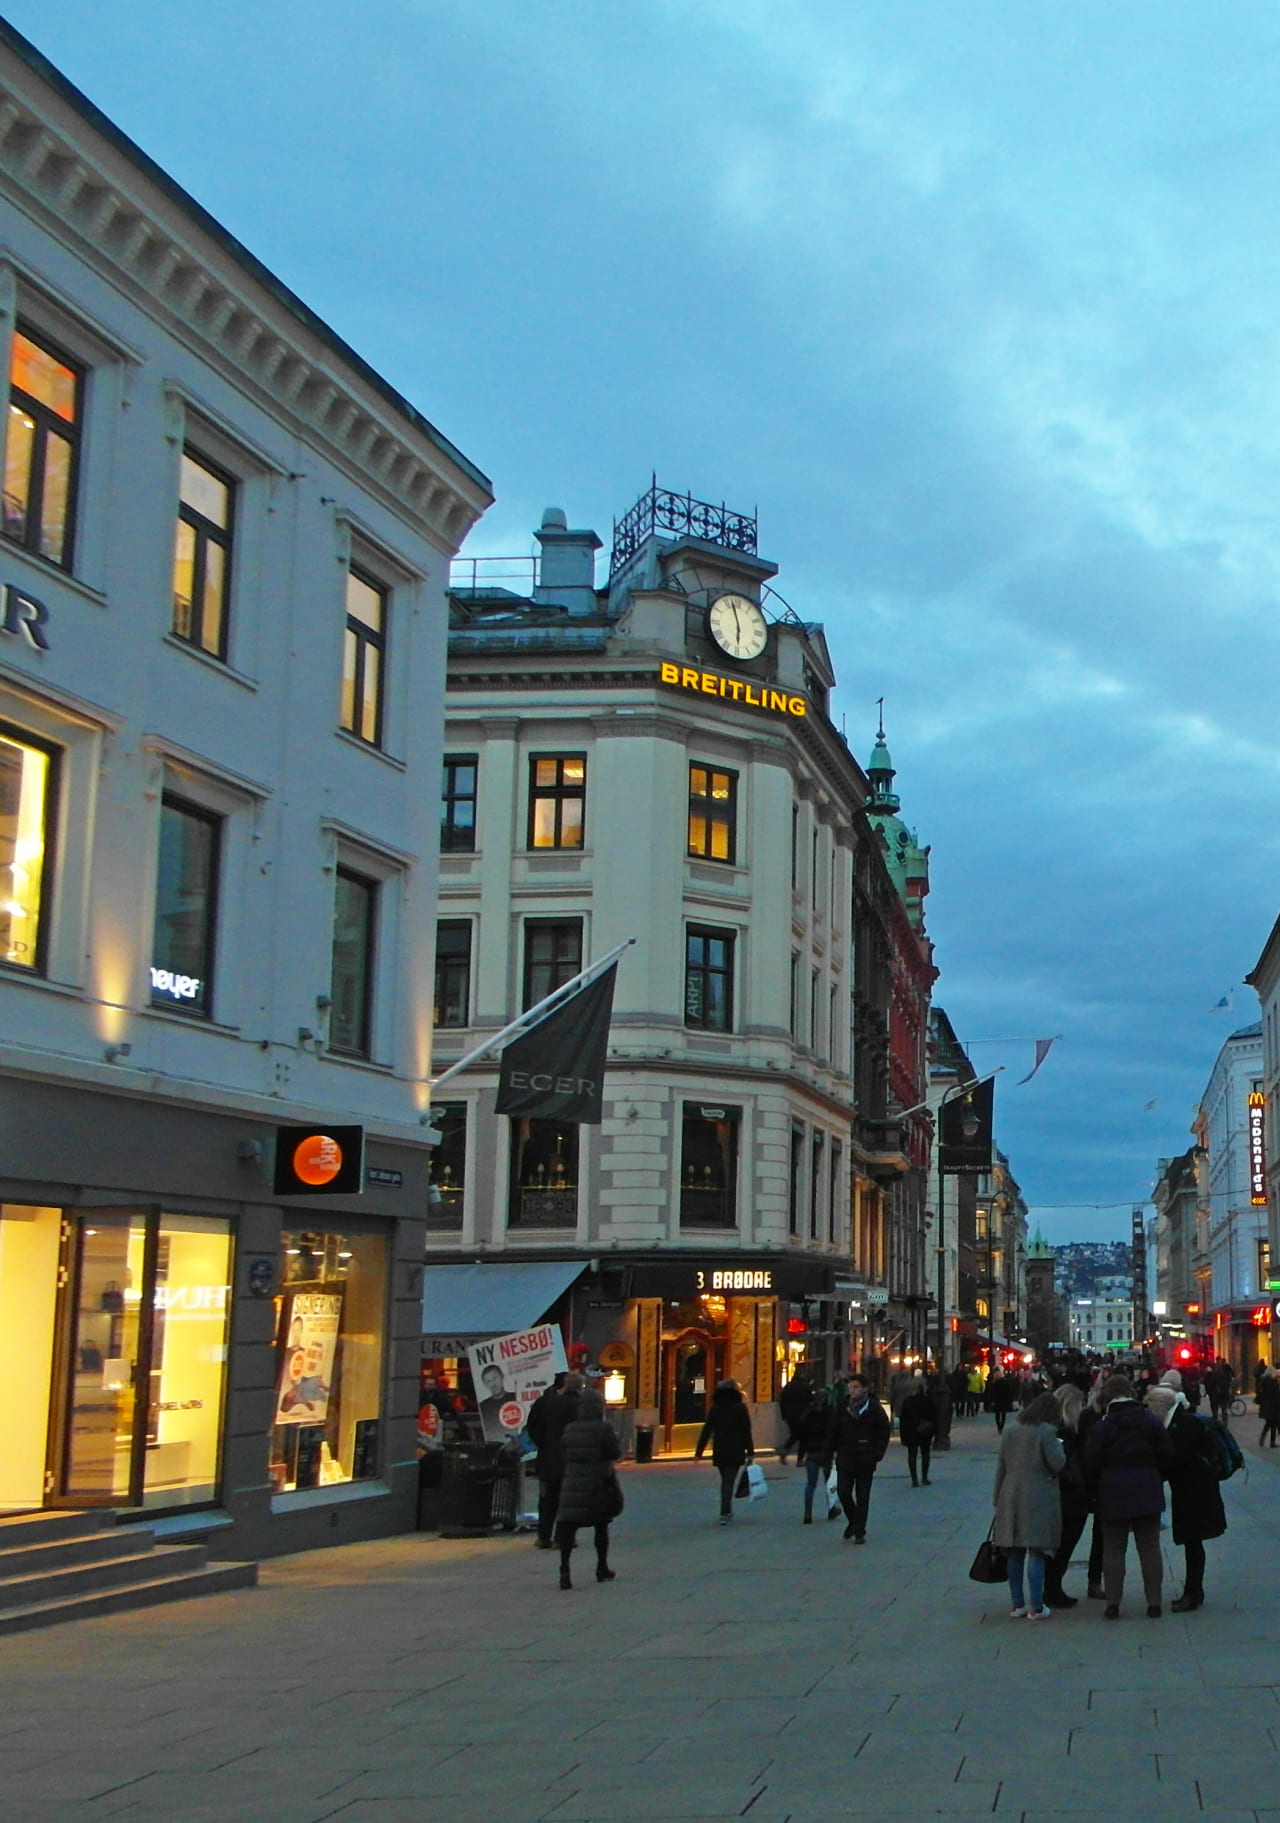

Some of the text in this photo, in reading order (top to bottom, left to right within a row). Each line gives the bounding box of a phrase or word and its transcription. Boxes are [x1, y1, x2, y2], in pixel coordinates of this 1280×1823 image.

[661, 662, 807, 716] BREITLING
[509, 1071, 595, 1096] EGER
[696, 1271, 771, 1289] 3 BRØDRE
[476, 1344, 495, 1366] NY
